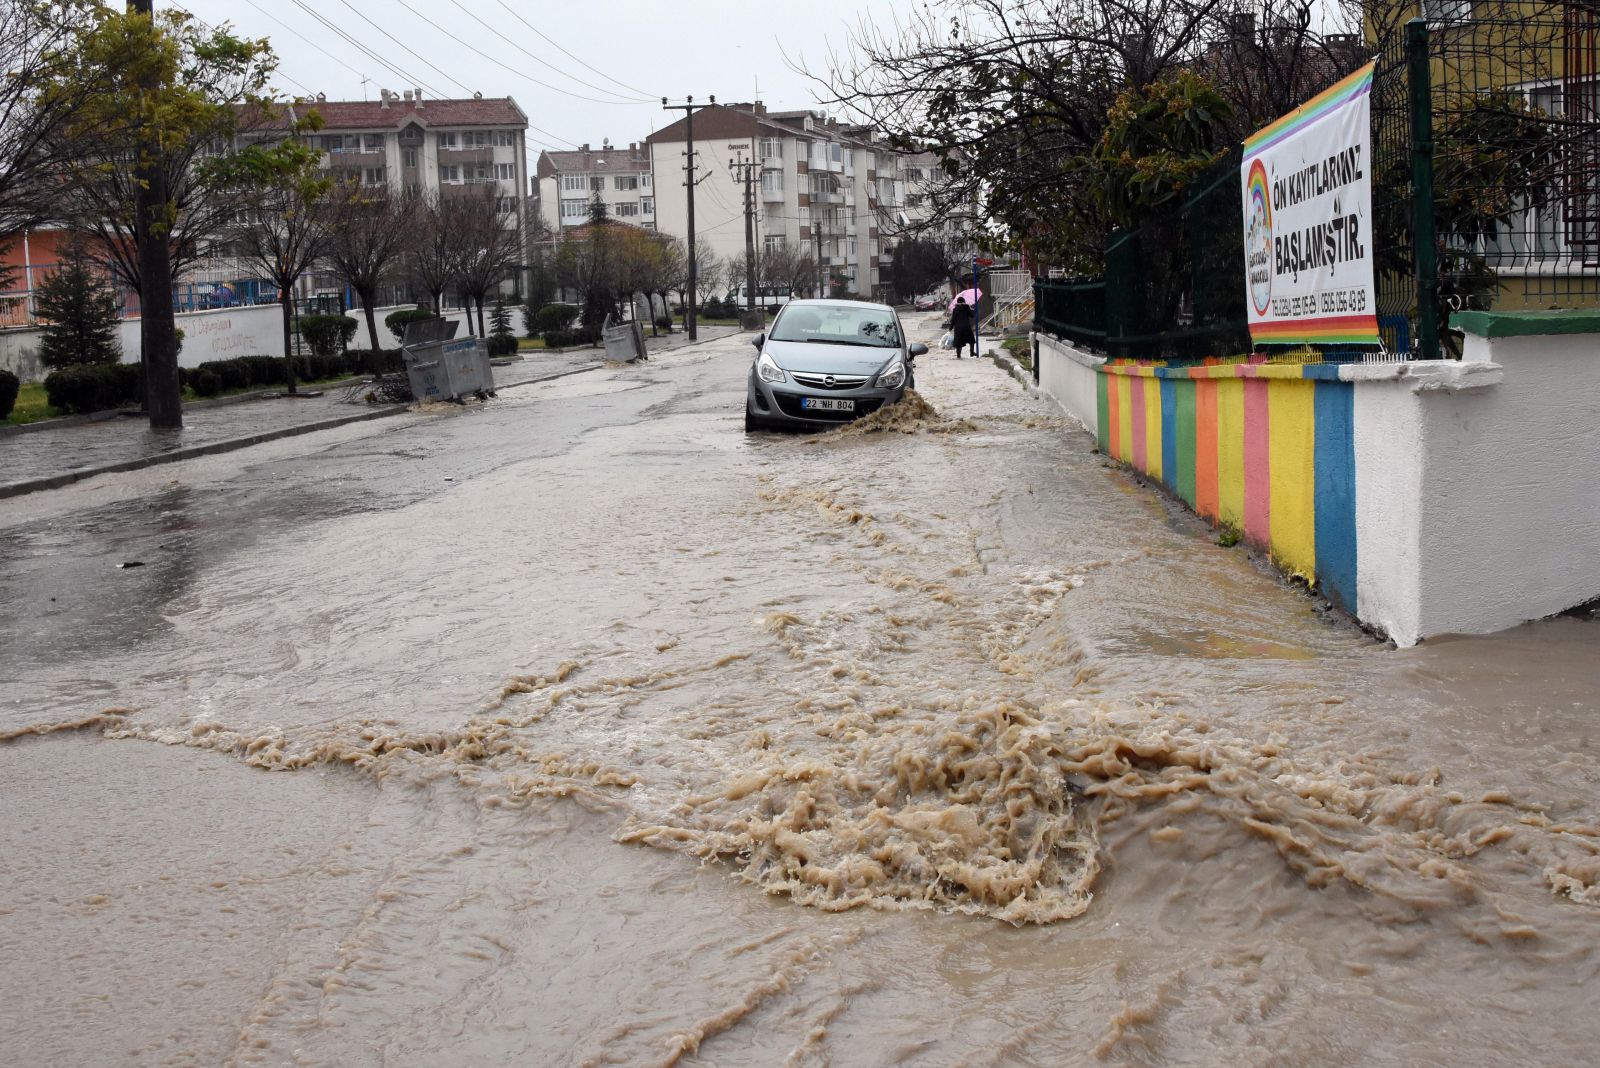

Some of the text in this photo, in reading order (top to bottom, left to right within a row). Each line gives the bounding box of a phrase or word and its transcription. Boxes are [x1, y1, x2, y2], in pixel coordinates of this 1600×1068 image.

[1273, 175, 1287, 212] ÖN
[1321, 292, 1335, 313] 0505
[1336, 290, 1347, 312] 056
[1349, 289, 1356, 312] 43
[1357, 288, 1366, 312] 89
[806, 400, 853, 410] 22 NH 804
